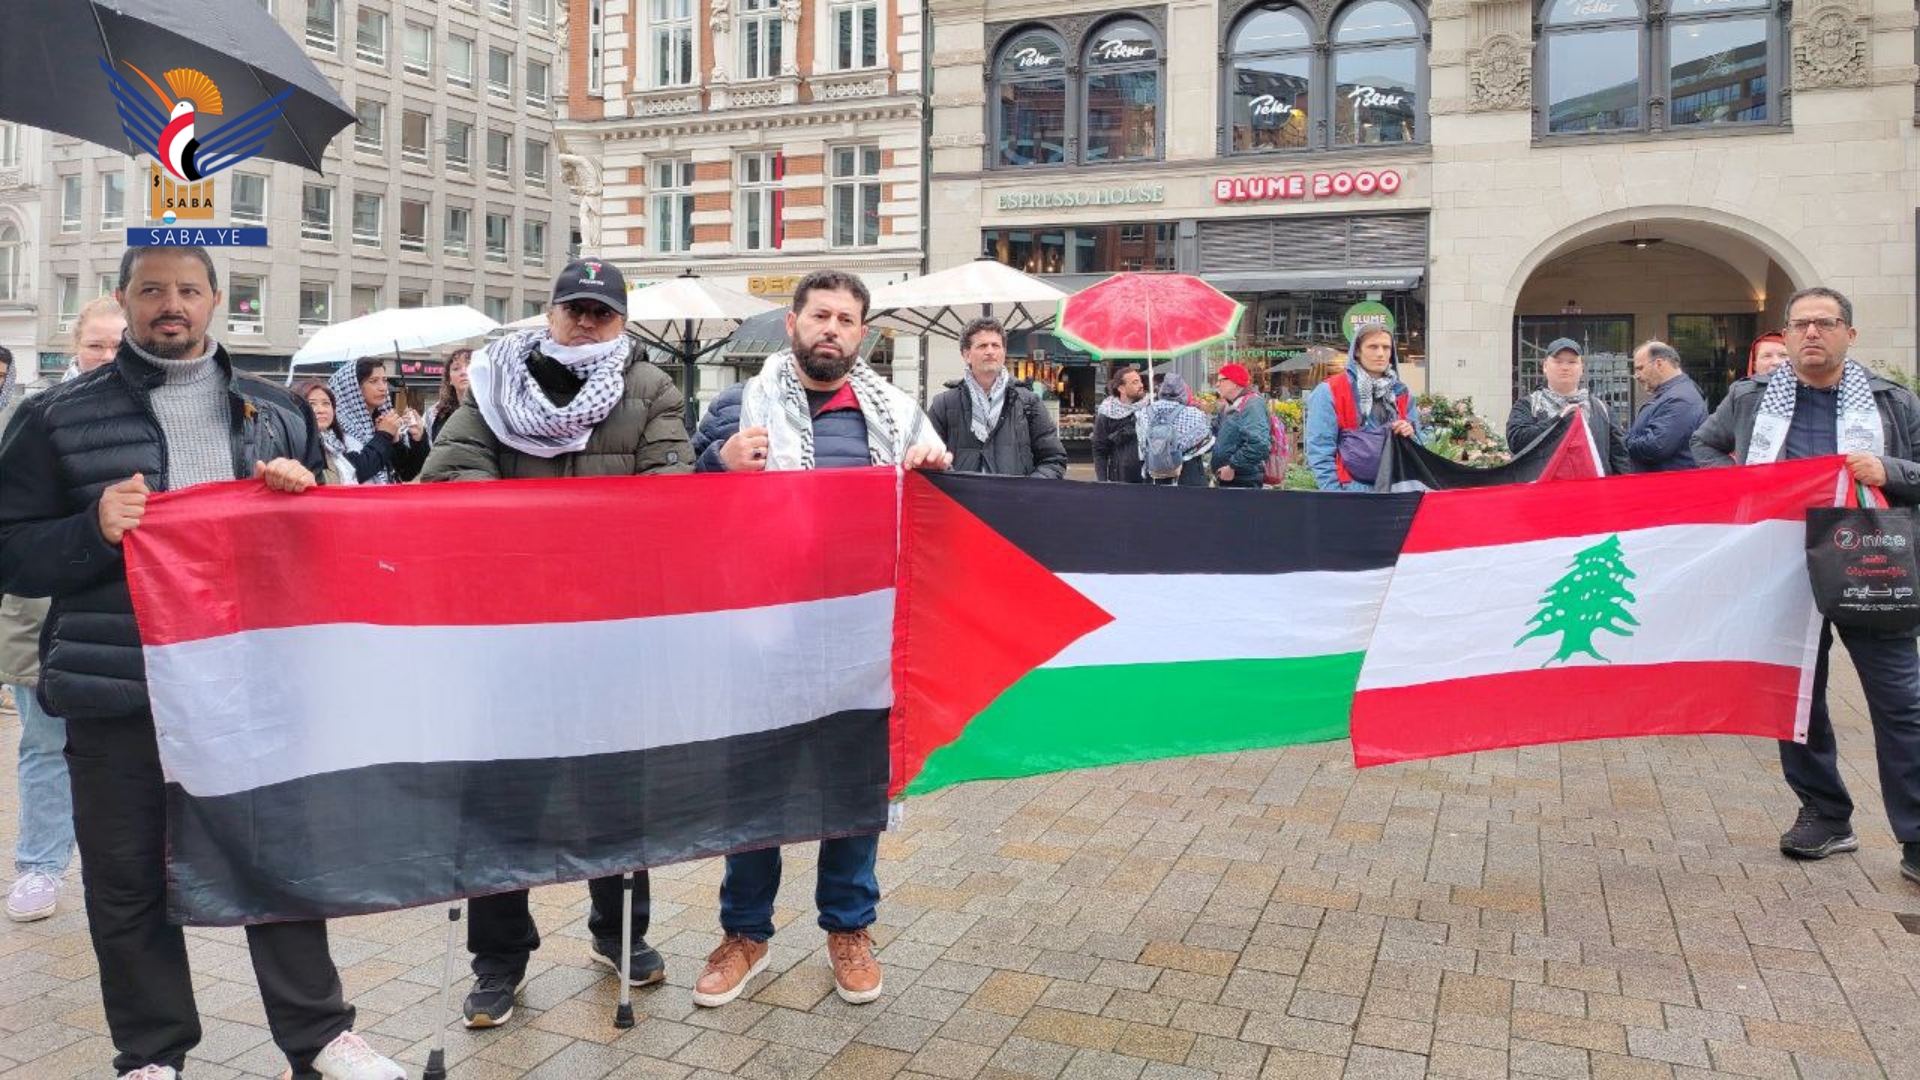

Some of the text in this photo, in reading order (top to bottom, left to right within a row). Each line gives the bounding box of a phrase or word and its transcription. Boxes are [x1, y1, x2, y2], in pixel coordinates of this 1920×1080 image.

[1249, 94, 1293, 115] Peter
[997, 184, 1165, 210] ESPRESSO HOUSE
[1216, 170, 1401, 202] BLUME 2000
[1350, 314, 1387, 324] BLUME
